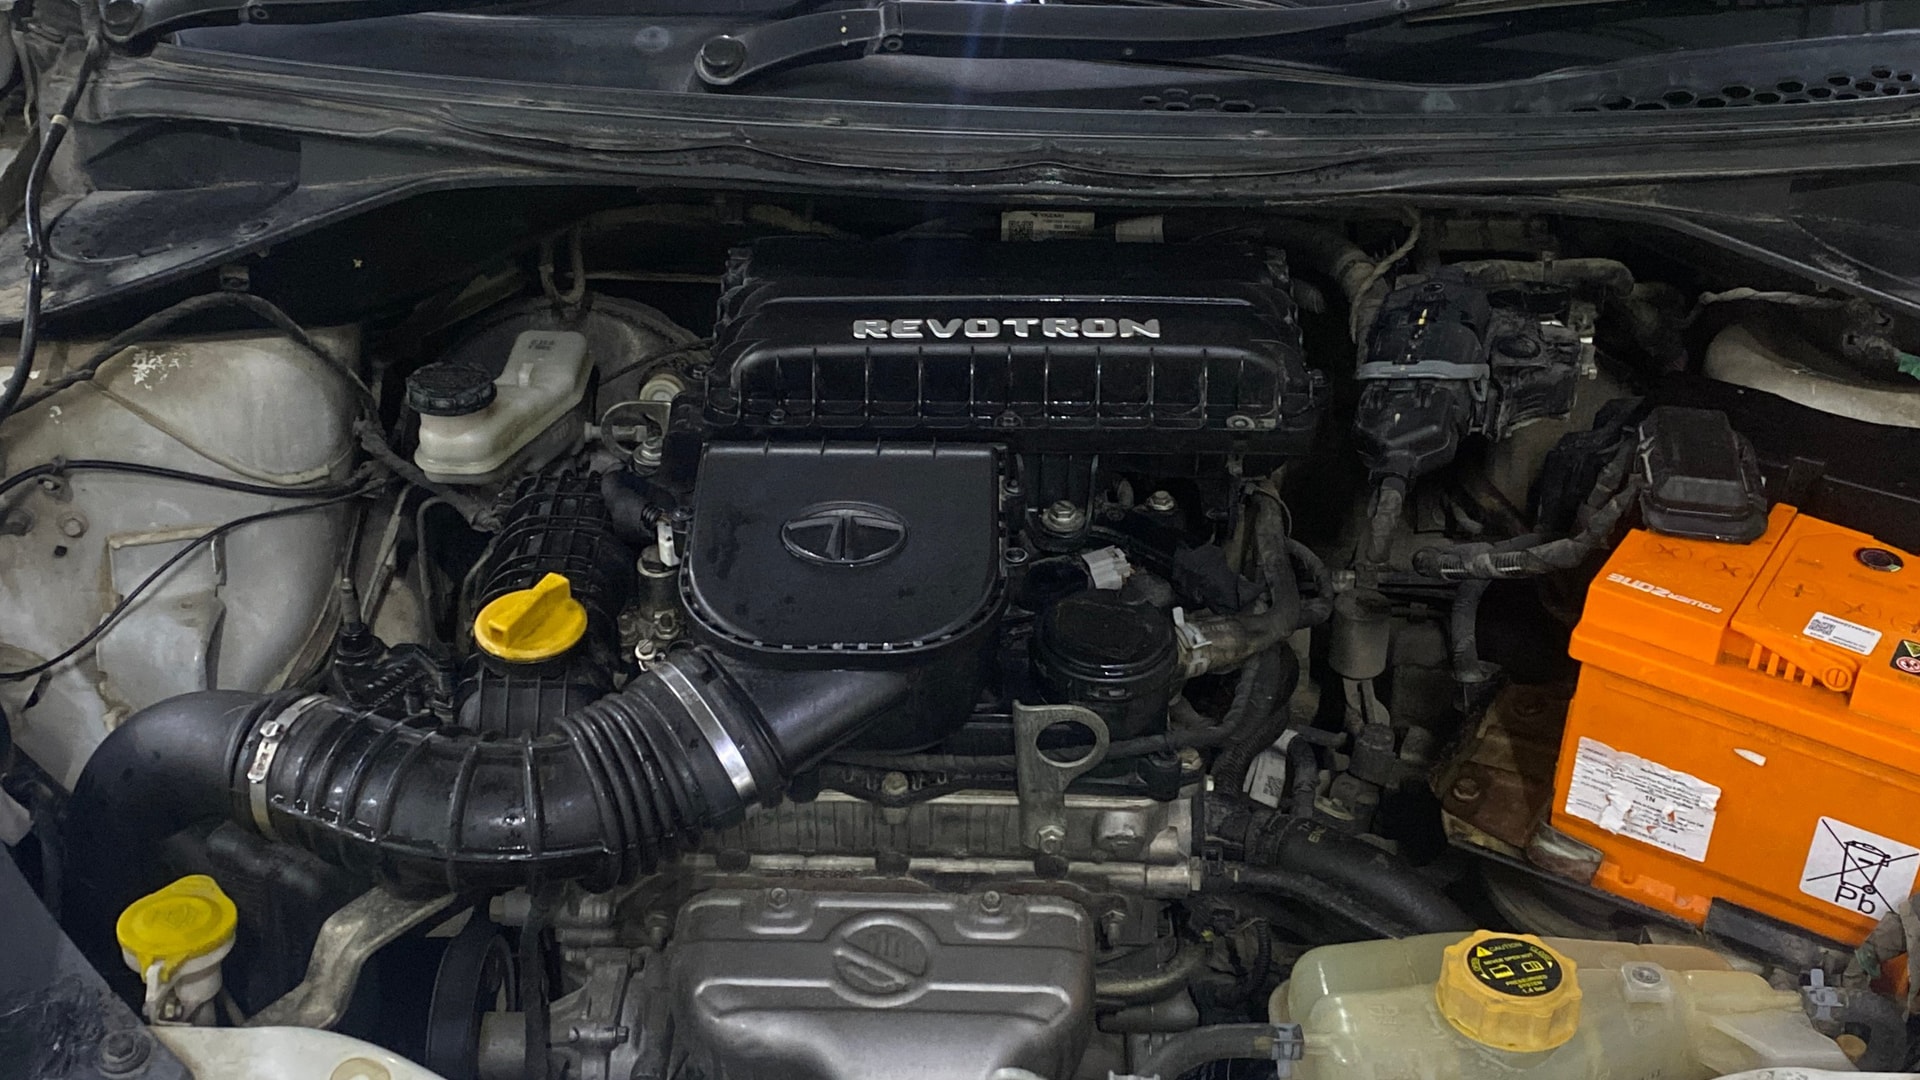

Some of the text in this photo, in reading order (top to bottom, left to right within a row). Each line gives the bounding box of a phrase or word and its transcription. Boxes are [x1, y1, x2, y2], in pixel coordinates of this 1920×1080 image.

[853, 318, 1161, 339] REVOTRON
[1834, 884, 1876, 915] Pb
[1489, 942, 1523, 951] CAUTION
